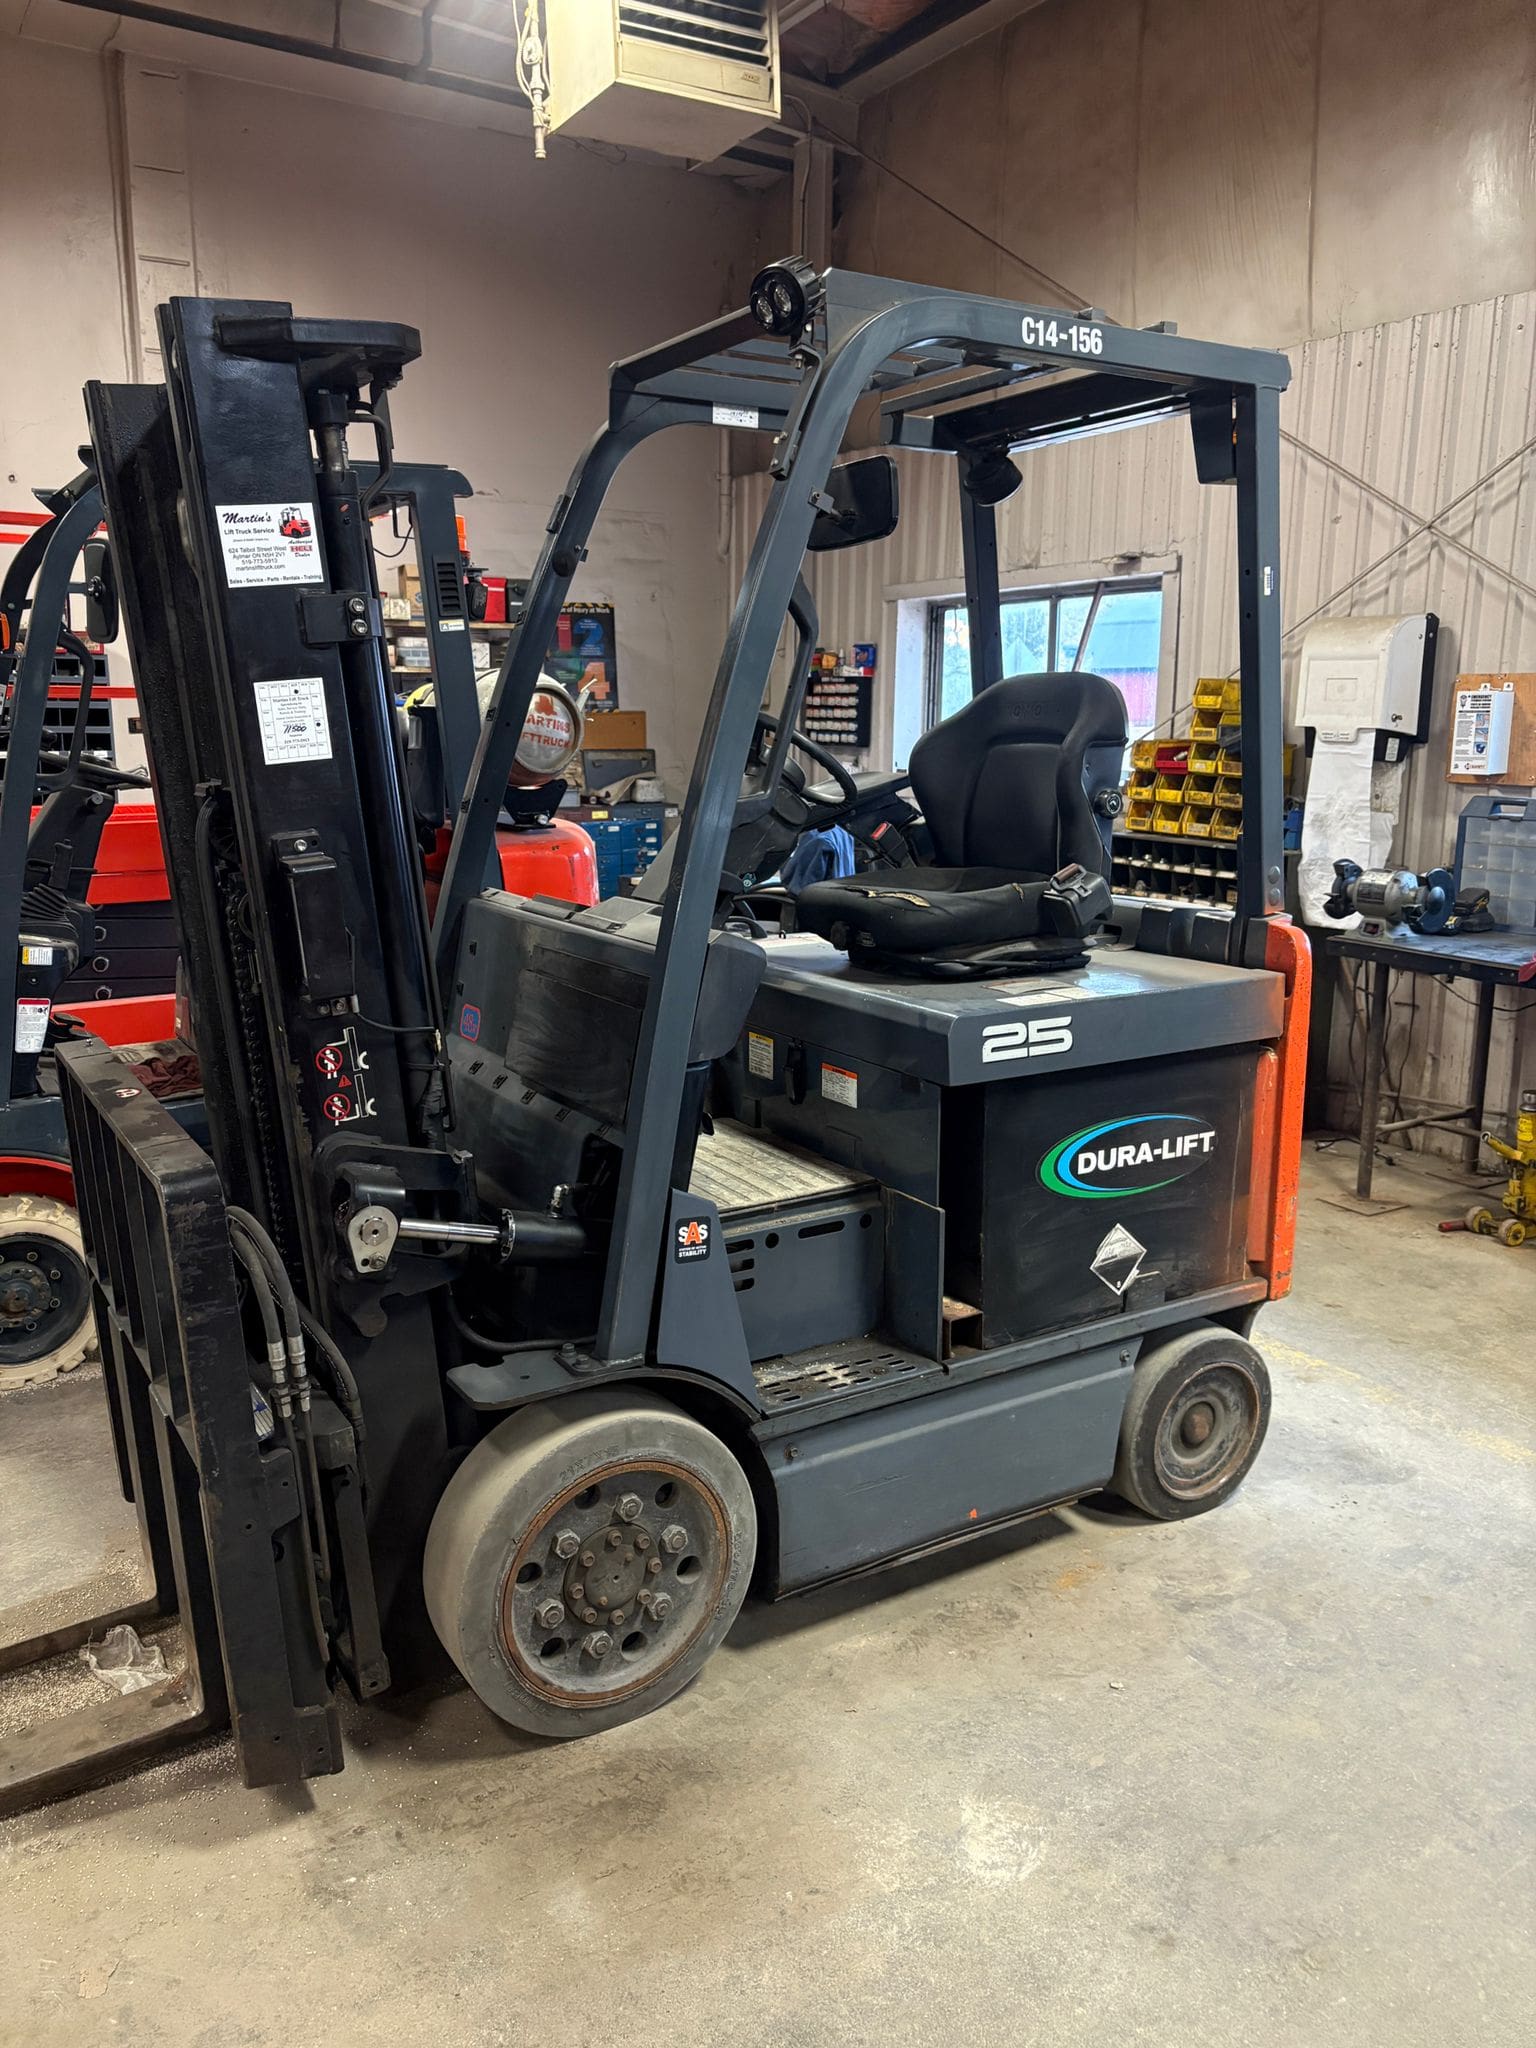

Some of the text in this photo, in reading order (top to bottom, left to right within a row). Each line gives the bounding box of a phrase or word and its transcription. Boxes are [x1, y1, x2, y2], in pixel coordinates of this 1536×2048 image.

[1021, 316, 1103, 355] C14-156
[222, 512, 272, 524] Martin's
[574, 618, 604, 656] 2
[577, 662, 610, 700] 4
[526, 714, 570, 733] ARTINS
[982, 1016, 1073, 1063] 25
[1077, 1131, 1216, 1176] DURA-LIFT
[678, 1222, 708, 1245] SAS
[679, 1249, 707, 1258] STABILITY
